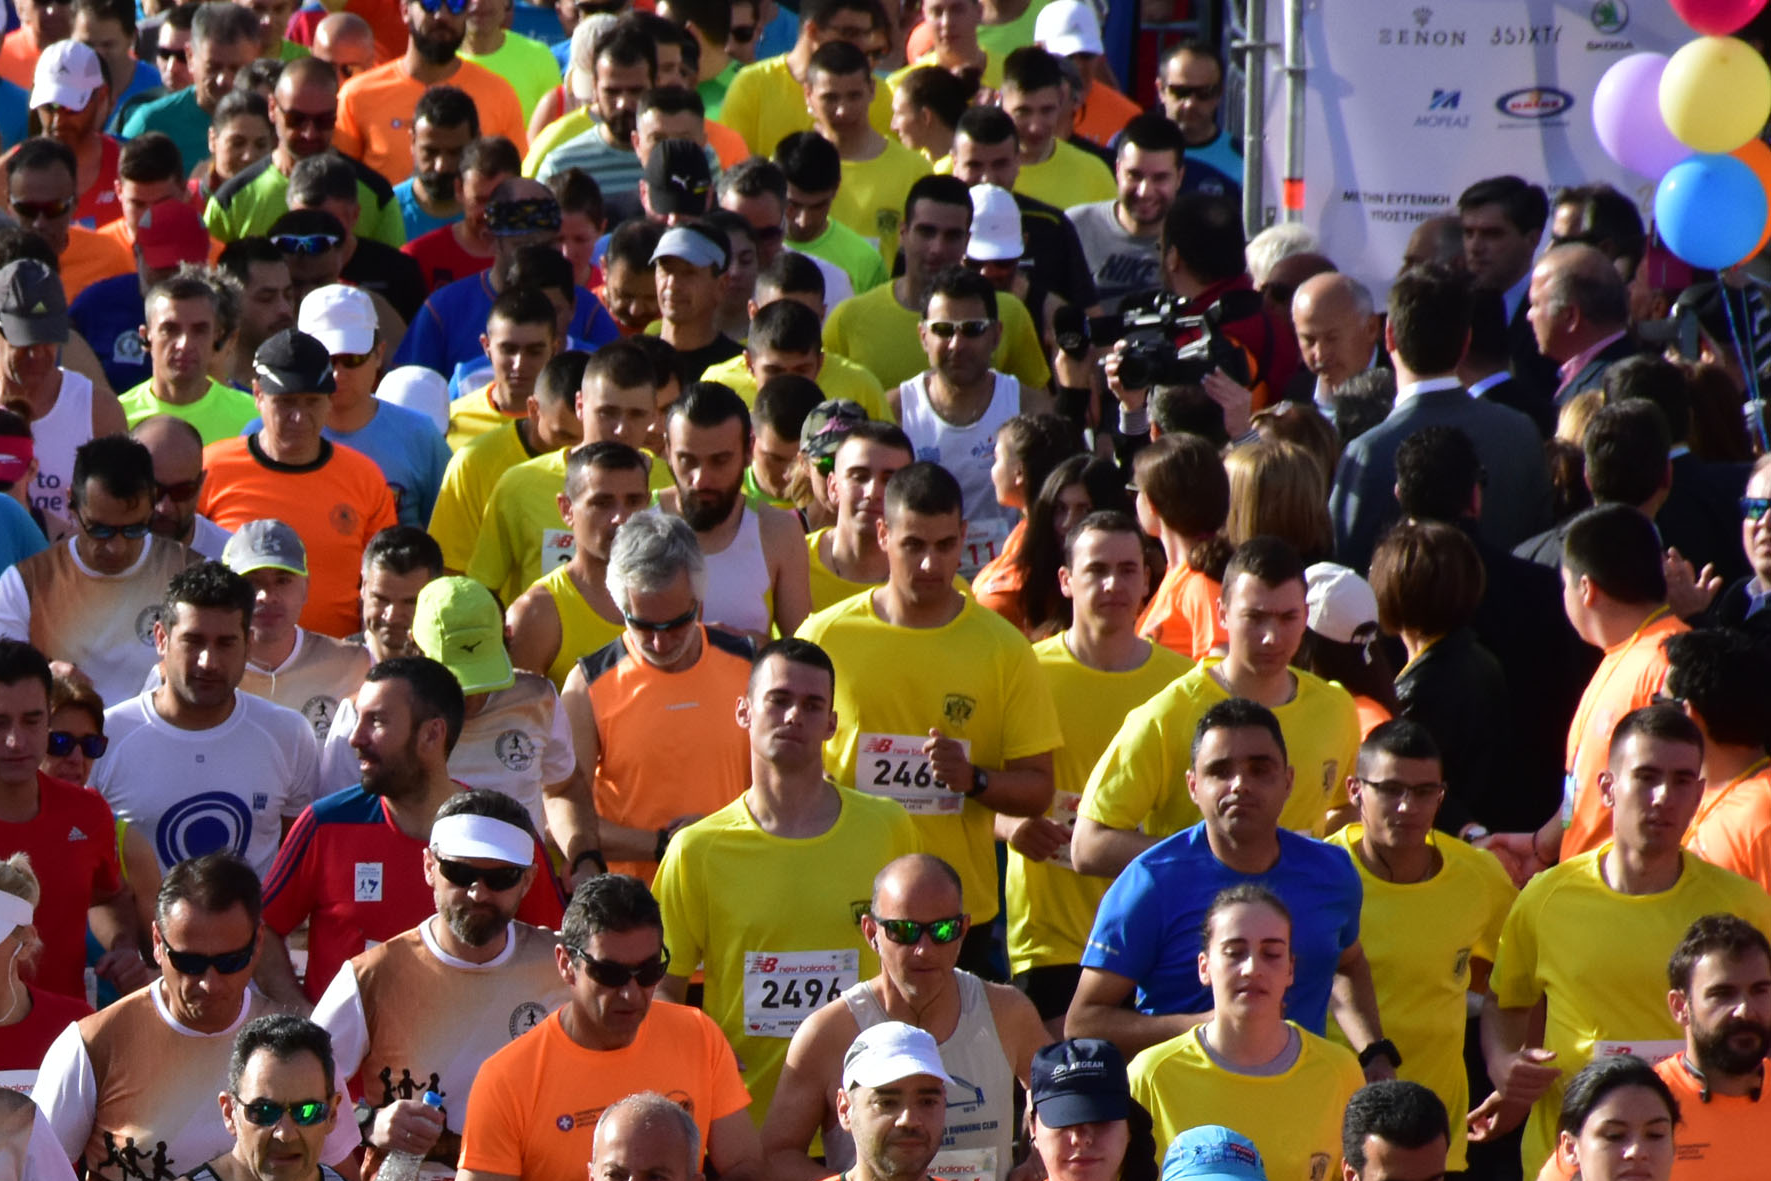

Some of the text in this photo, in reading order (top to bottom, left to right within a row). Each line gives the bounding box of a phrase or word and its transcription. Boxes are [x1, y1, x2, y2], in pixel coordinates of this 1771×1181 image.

[37, 473, 61, 490] to
[800, 964, 837, 973] balance
[1070, 1061, 1104, 1071] AEGEAN
[983, 1120, 999, 1133] CLUB
